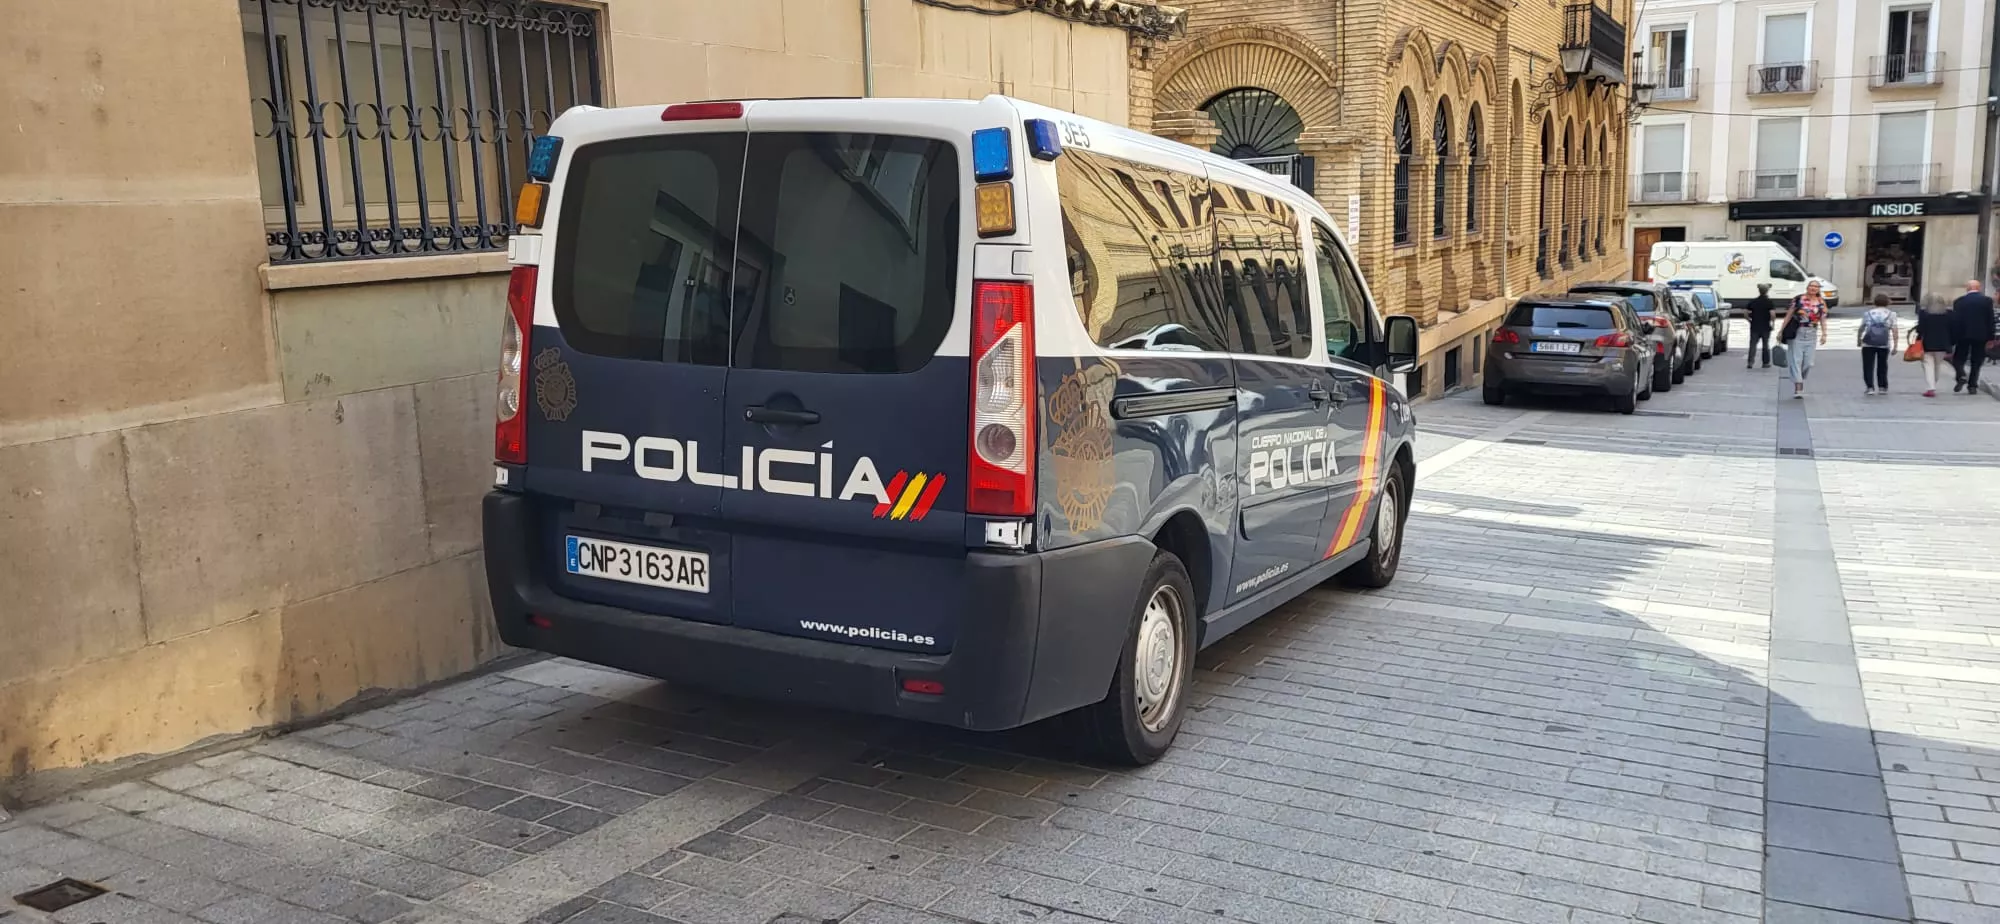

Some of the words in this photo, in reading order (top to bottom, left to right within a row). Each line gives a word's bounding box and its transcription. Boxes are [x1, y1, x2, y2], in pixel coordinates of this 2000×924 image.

[1060, 119, 1090, 148] 3E5
[1871, 202, 1924, 216] INSIDE
[1252, 433, 1282, 449] CUERPO
[1283, 429, 1314, 444] NACIONAL
[1315, 428, 1324, 440] DE
[582, 430, 892, 505] POLICÍA
[1236, 562, 1289, 594] www.policia.es
[800, 619, 935, 645] www.policia.es
